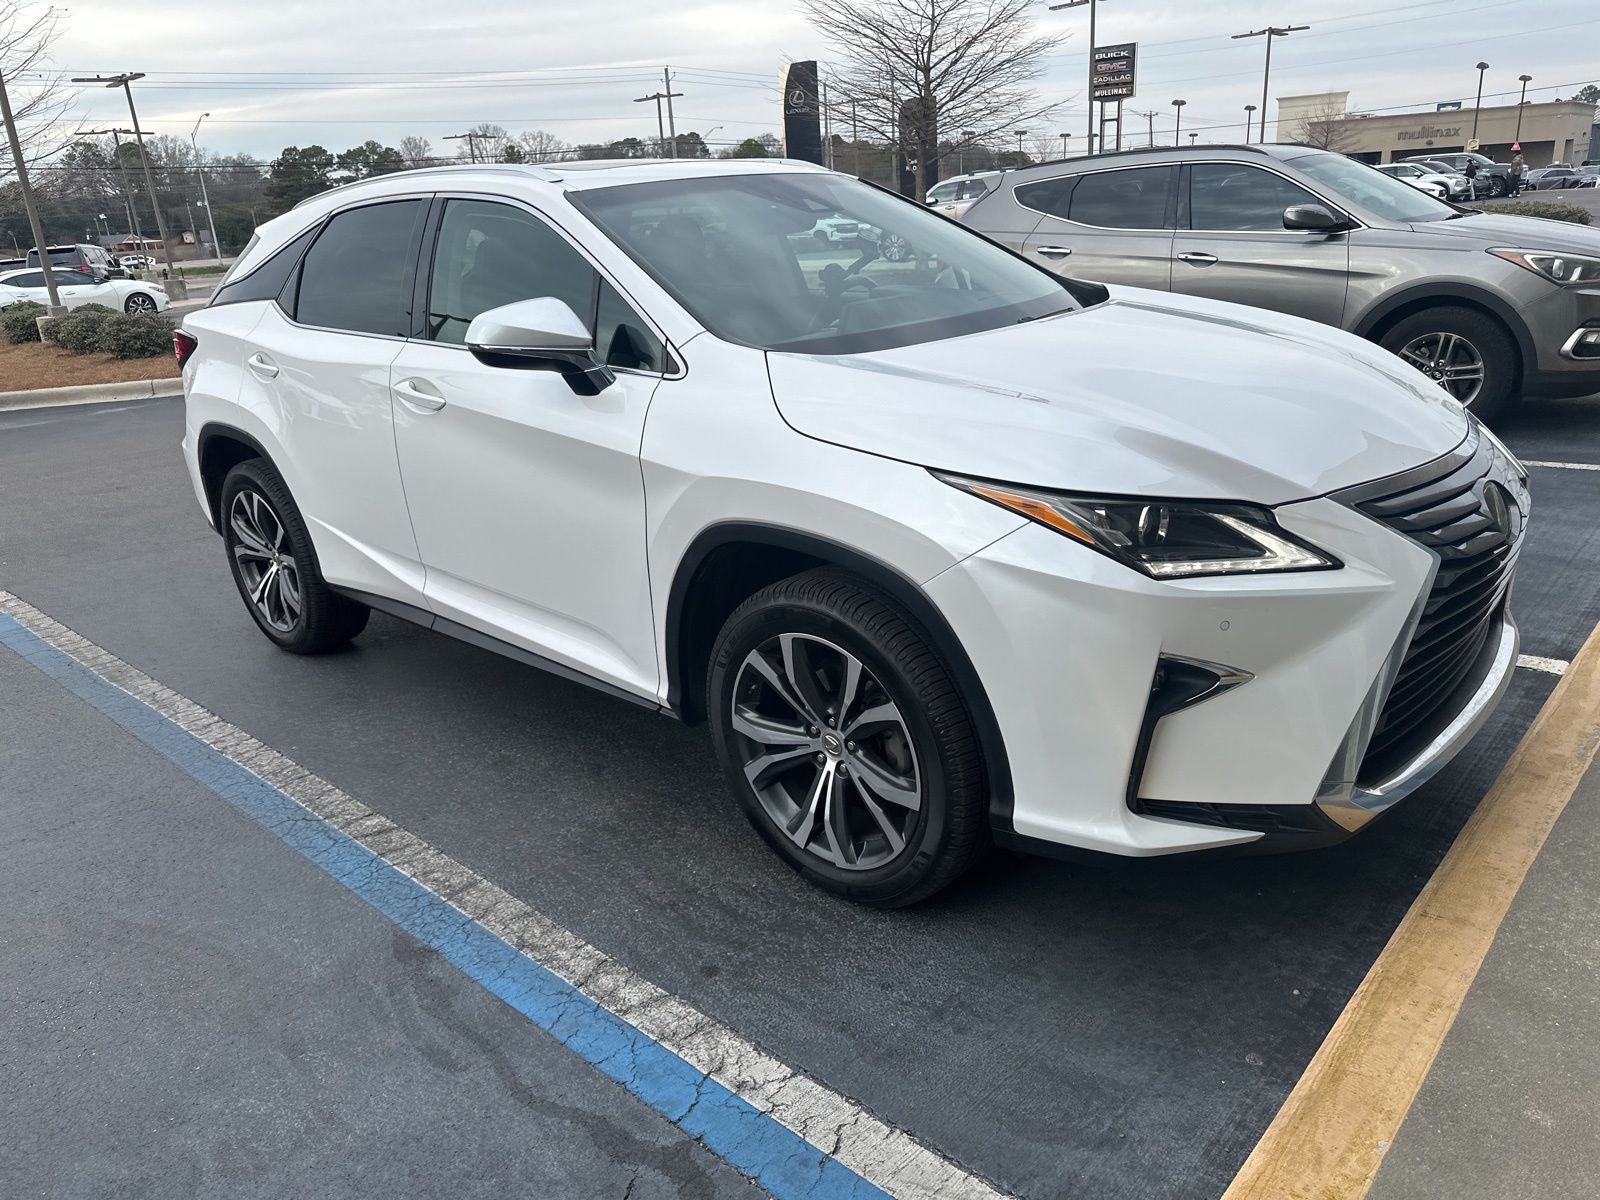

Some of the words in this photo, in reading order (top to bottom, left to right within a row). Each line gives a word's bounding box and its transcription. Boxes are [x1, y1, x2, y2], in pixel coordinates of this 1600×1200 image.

[1095, 50, 1129, 60] BUICK
[1096, 61, 1127, 72] GMC
[1094, 87, 1127, 97] MULLINAX
[1397, 126, 1462, 141] mullinax
